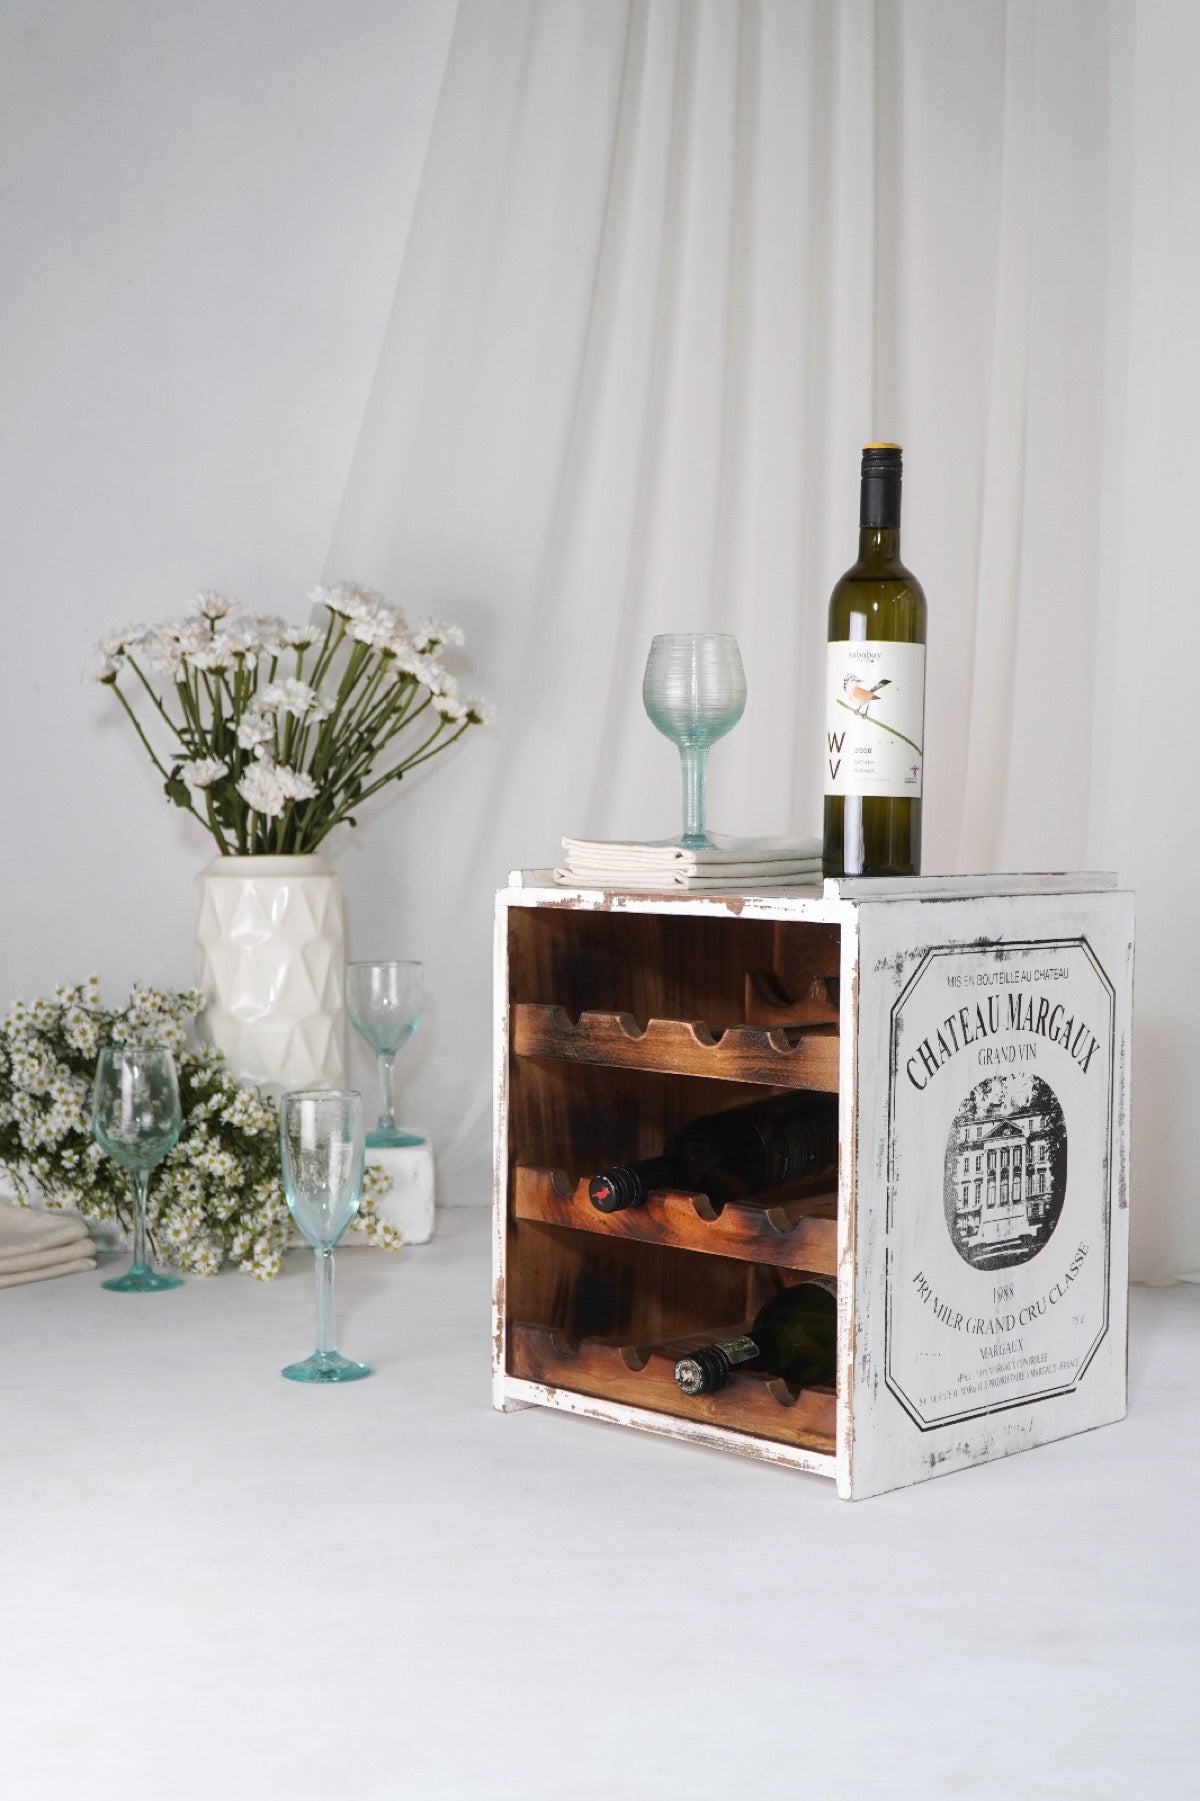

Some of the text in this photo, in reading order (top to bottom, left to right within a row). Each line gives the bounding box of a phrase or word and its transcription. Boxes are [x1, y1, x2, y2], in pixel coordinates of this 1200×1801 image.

[828, 731, 845, 753] W
[829, 759, 841, 780] V
[947, 975, 962, 988] MIS
[976, 970, 1020, 986] BOUTEILLE
[1021, 969, 1032, 983] AU
[1034, 967, 1070, 981] CHATEAU
[906, 993, 1101, 1091] CHATEAU MARGAUX
[978, 1042, 1037, 1066] GRAND VIN
[966, 1314, 1016, 1336] GRAND
[1019, 1297, 1047, 1327] CRU
[1048, 1240, 1090, 1305] CLASSE
[979, 1338, 1024, 1360] MARGAUX
